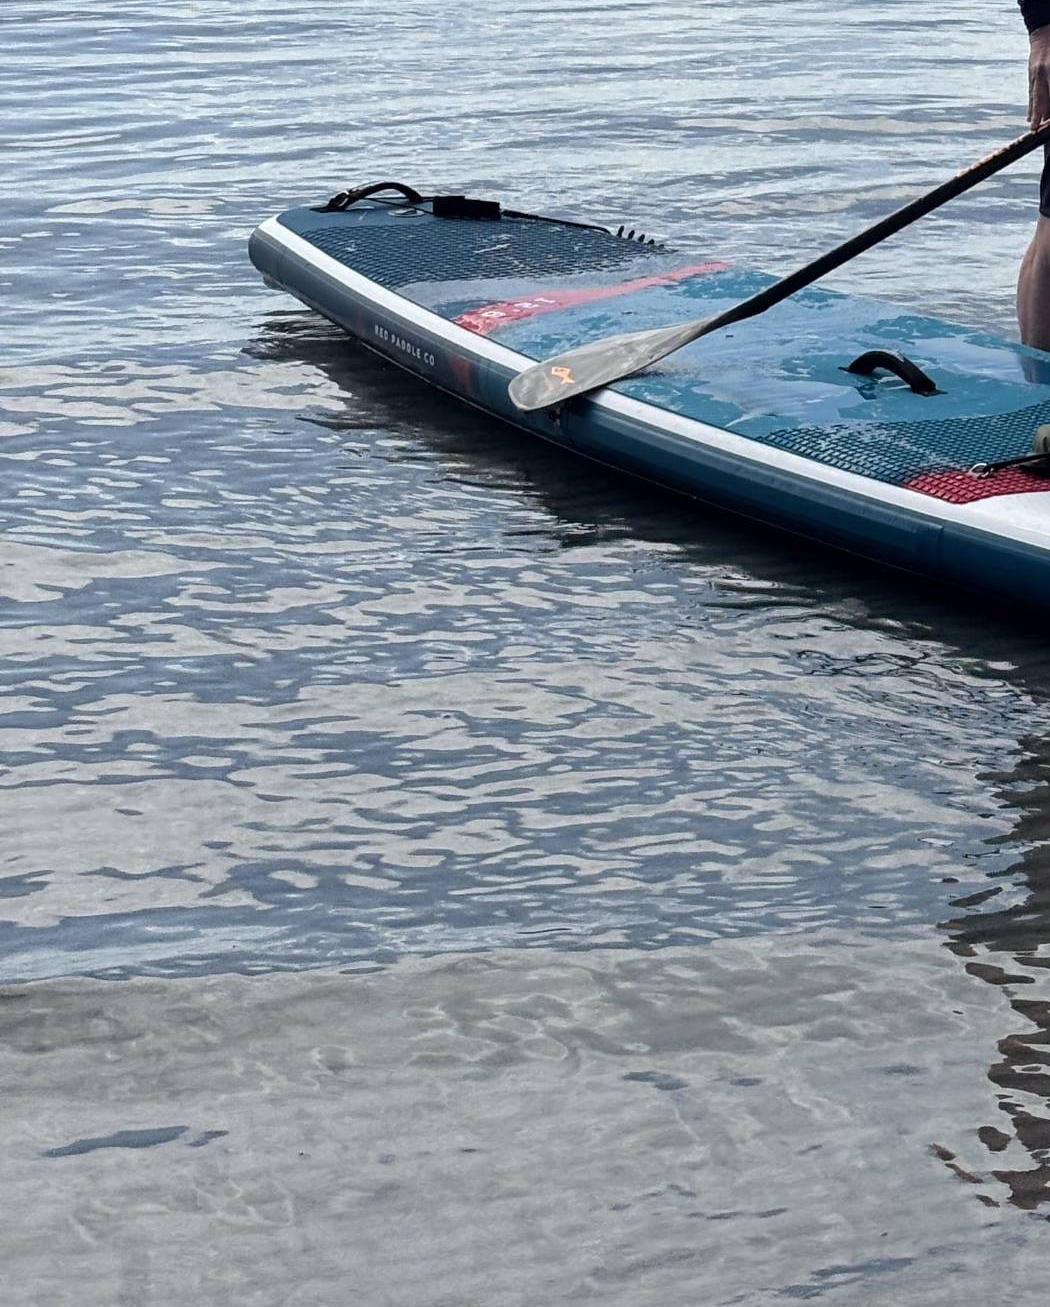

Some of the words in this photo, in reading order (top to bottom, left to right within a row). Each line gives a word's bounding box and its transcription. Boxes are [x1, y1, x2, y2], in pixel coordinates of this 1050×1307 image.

[374, 324, 389, 341] RED
[391, 334, 421, 359] PADDLE
[423, 352, 435, 366] CO
